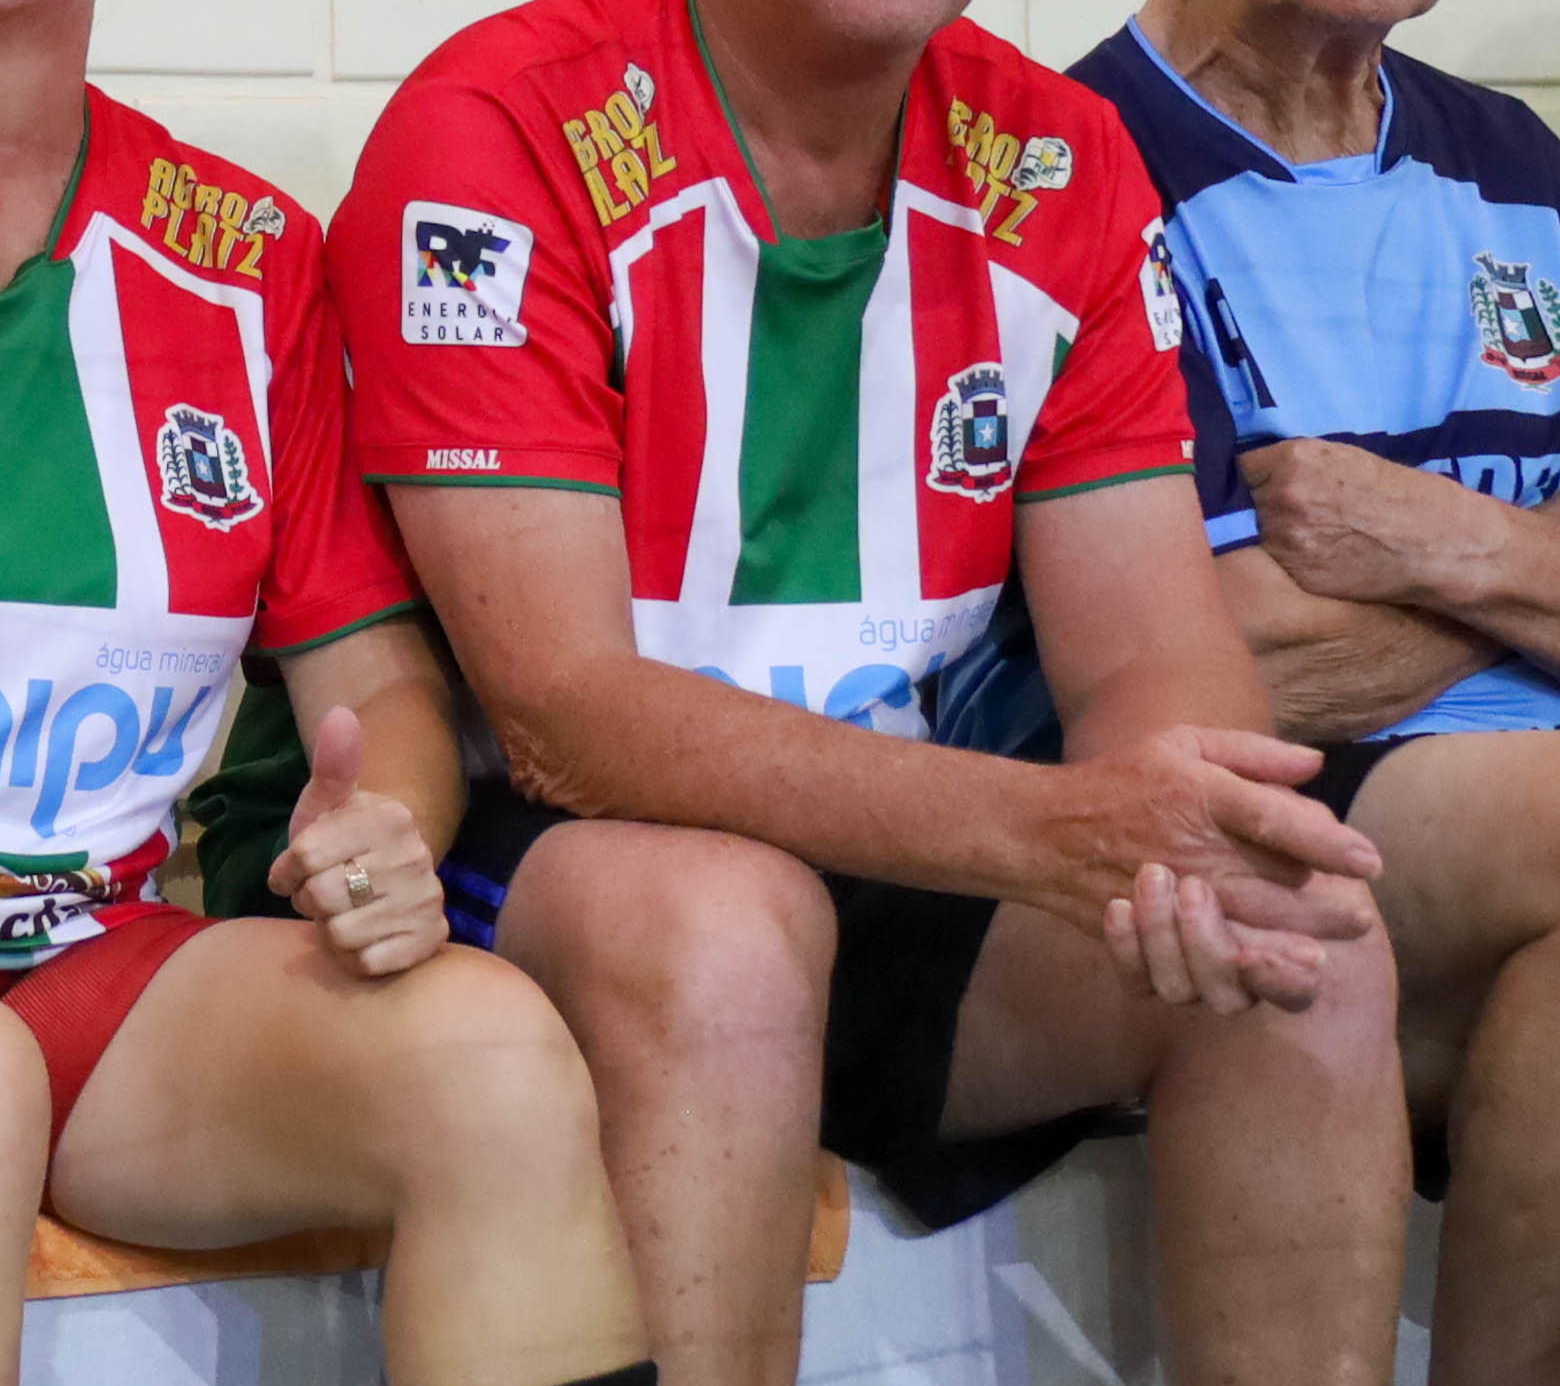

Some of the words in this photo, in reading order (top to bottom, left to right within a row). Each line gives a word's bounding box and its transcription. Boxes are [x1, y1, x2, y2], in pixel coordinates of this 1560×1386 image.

[149, 157, 249, 229] AGRO
[141, 188, 264, 281] PLATZ
[420, 325, 504, 342] SOLAR
[426, 448, 502, 470] MISSAL
[858, 613, 936, 652] água
[95, 642, 153, 675] água
